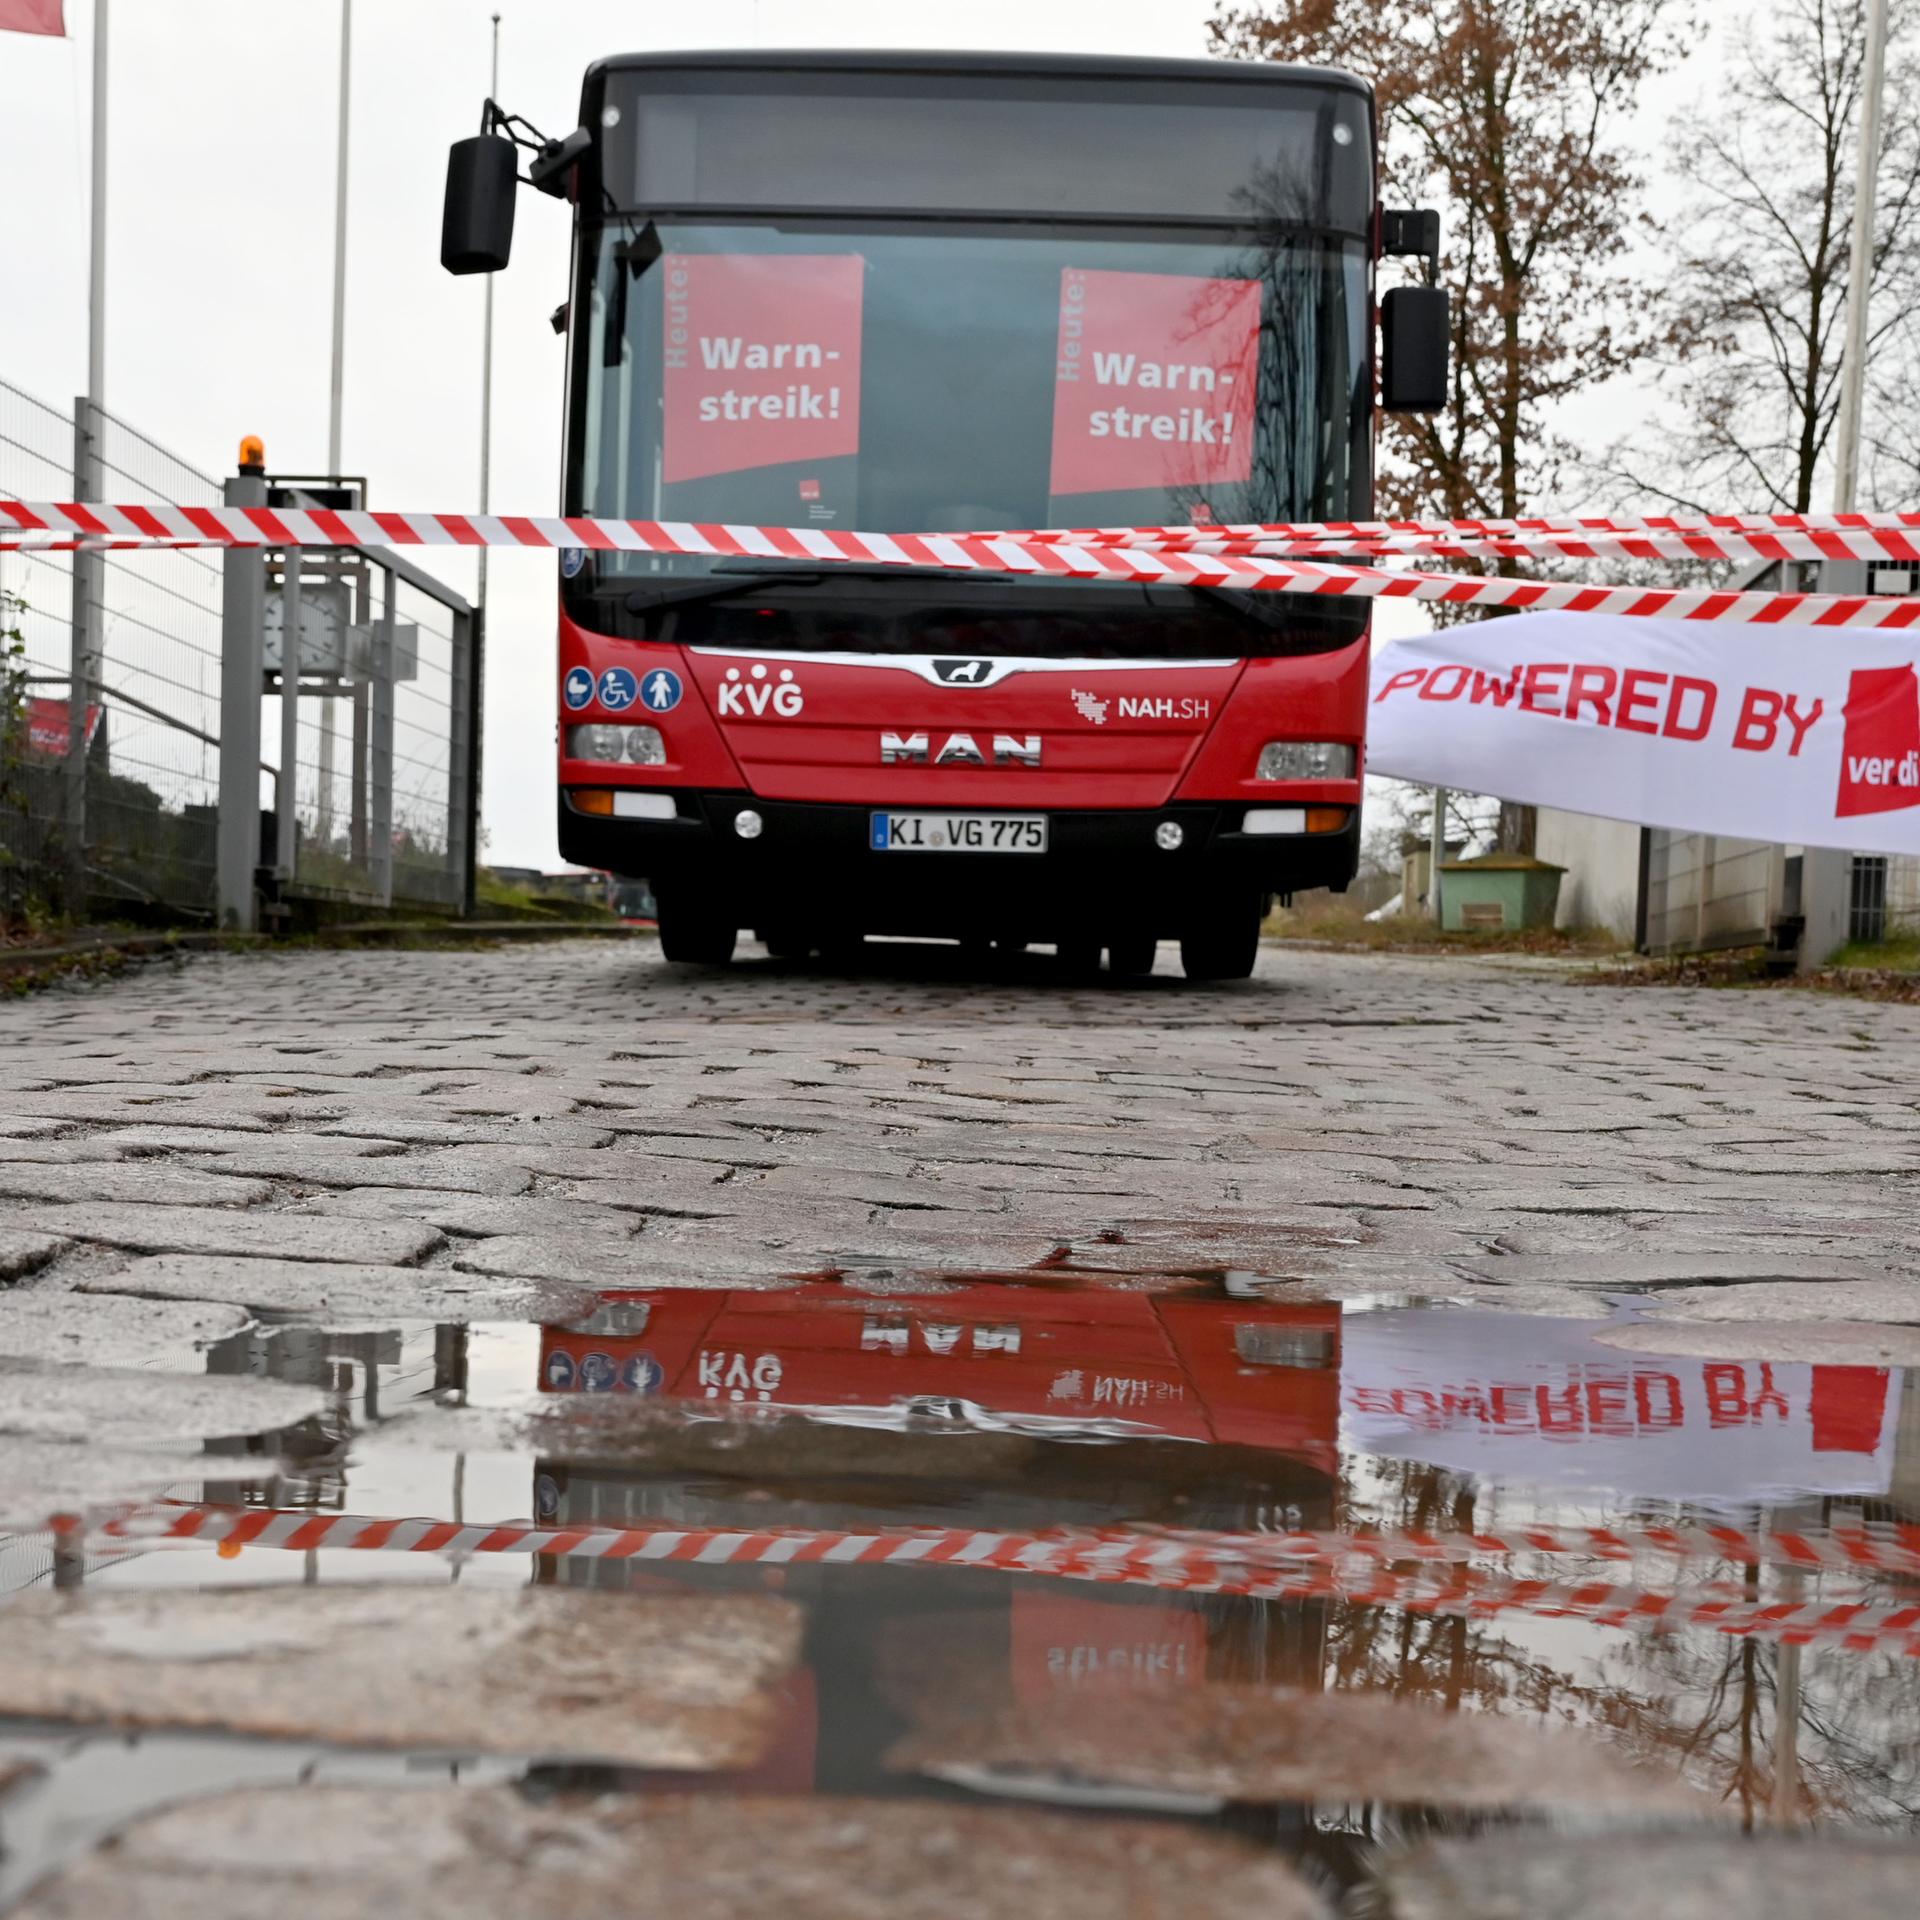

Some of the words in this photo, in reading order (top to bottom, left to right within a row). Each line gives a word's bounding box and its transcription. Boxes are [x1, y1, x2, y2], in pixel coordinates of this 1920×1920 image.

[664, 257, 688, 368] Heute:
[1057, 273, 1087, 382] Heute:
[699, 337, 841, 370] Warn-
[1092, 352, 1234, 392] Warn-
[699, 385, 840, 421] streik!
[1089, 406, 1234, 444] streik!
[718, 682, 804, 717] KVG
[1118, 697, 1210, 719] NAH.SH
[1374, 663, 1718, 743] POWERED
[1731, 686, 1823, 757] BY
[880, 732, 1042, 766] MAN
[1847, 749, 1919, 787] ver.di
[890, 818, 925, 846] KI
[947, 819, 983, 847] VG
[990, 820, 1043, 848] 775
